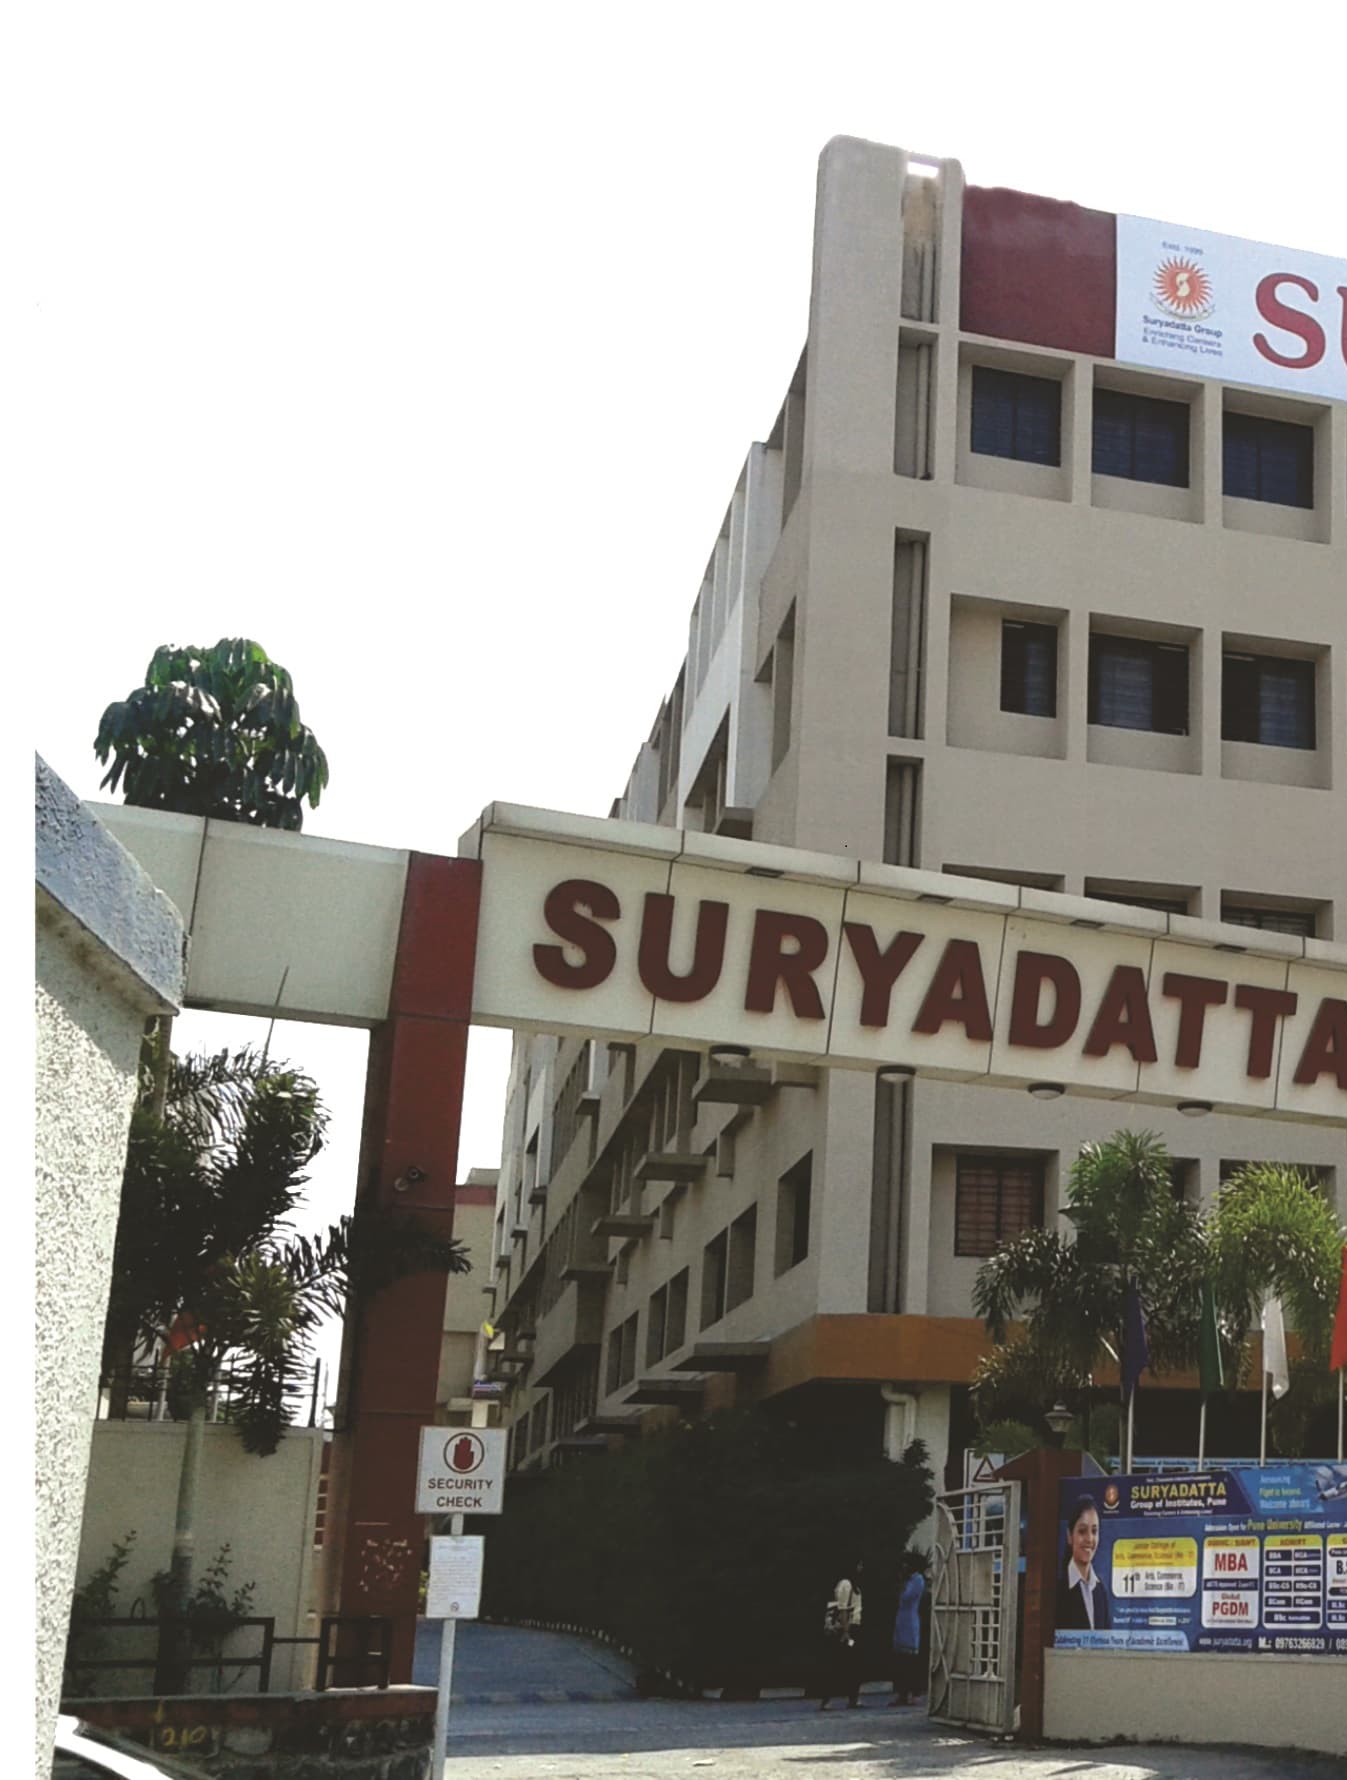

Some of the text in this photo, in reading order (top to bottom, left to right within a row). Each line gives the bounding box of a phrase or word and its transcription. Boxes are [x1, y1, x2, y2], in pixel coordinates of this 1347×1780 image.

[1142, 315, 1223, 339] Suryadatta Group
[428, 1478, 493, 1490] SECURITY
[1131, 1481, 1226, 1499] SURYADATTA
[436, 1496, 483, 1508] CHECK
[1130, 1499, 1154, 1511] Group
[1155, 1498, 1163, 1508] of
[1214, 1552, 1248, 1571] MBA
[1212, 1602, 1249, 1616] PGDM
